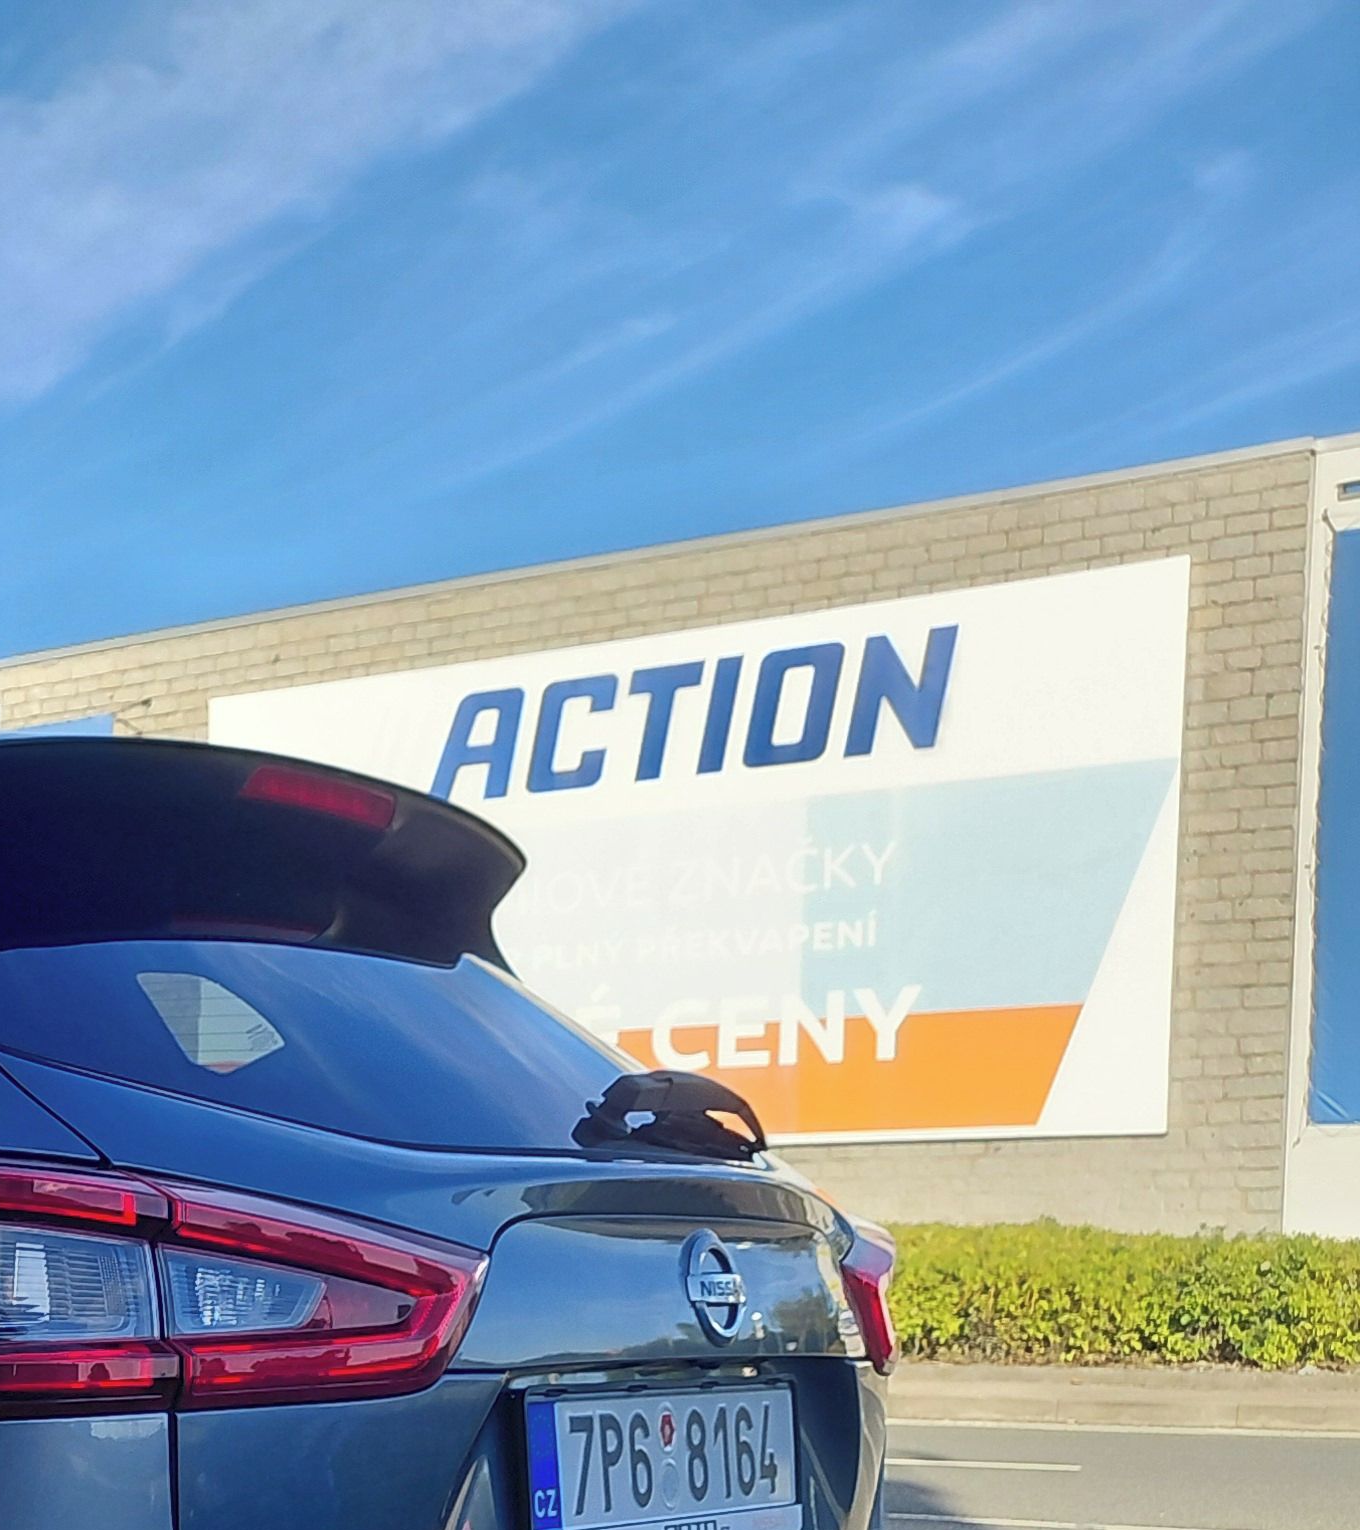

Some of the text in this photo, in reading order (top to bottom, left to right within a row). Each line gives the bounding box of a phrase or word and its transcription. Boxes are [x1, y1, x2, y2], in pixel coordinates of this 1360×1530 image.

[429, 625, 959, 801] ACTION
[667, 836, 897, 905] ZNAČKY
[636, 910, 878, 964] PŘEKVAPENÍ
[650, 984, 922, 1072] CENY
[700, 1280, 744, 1297] NISS
[568, 1401, 778, 1517] 7P6 8164
[533, 1488, 557, 1519] CZ
